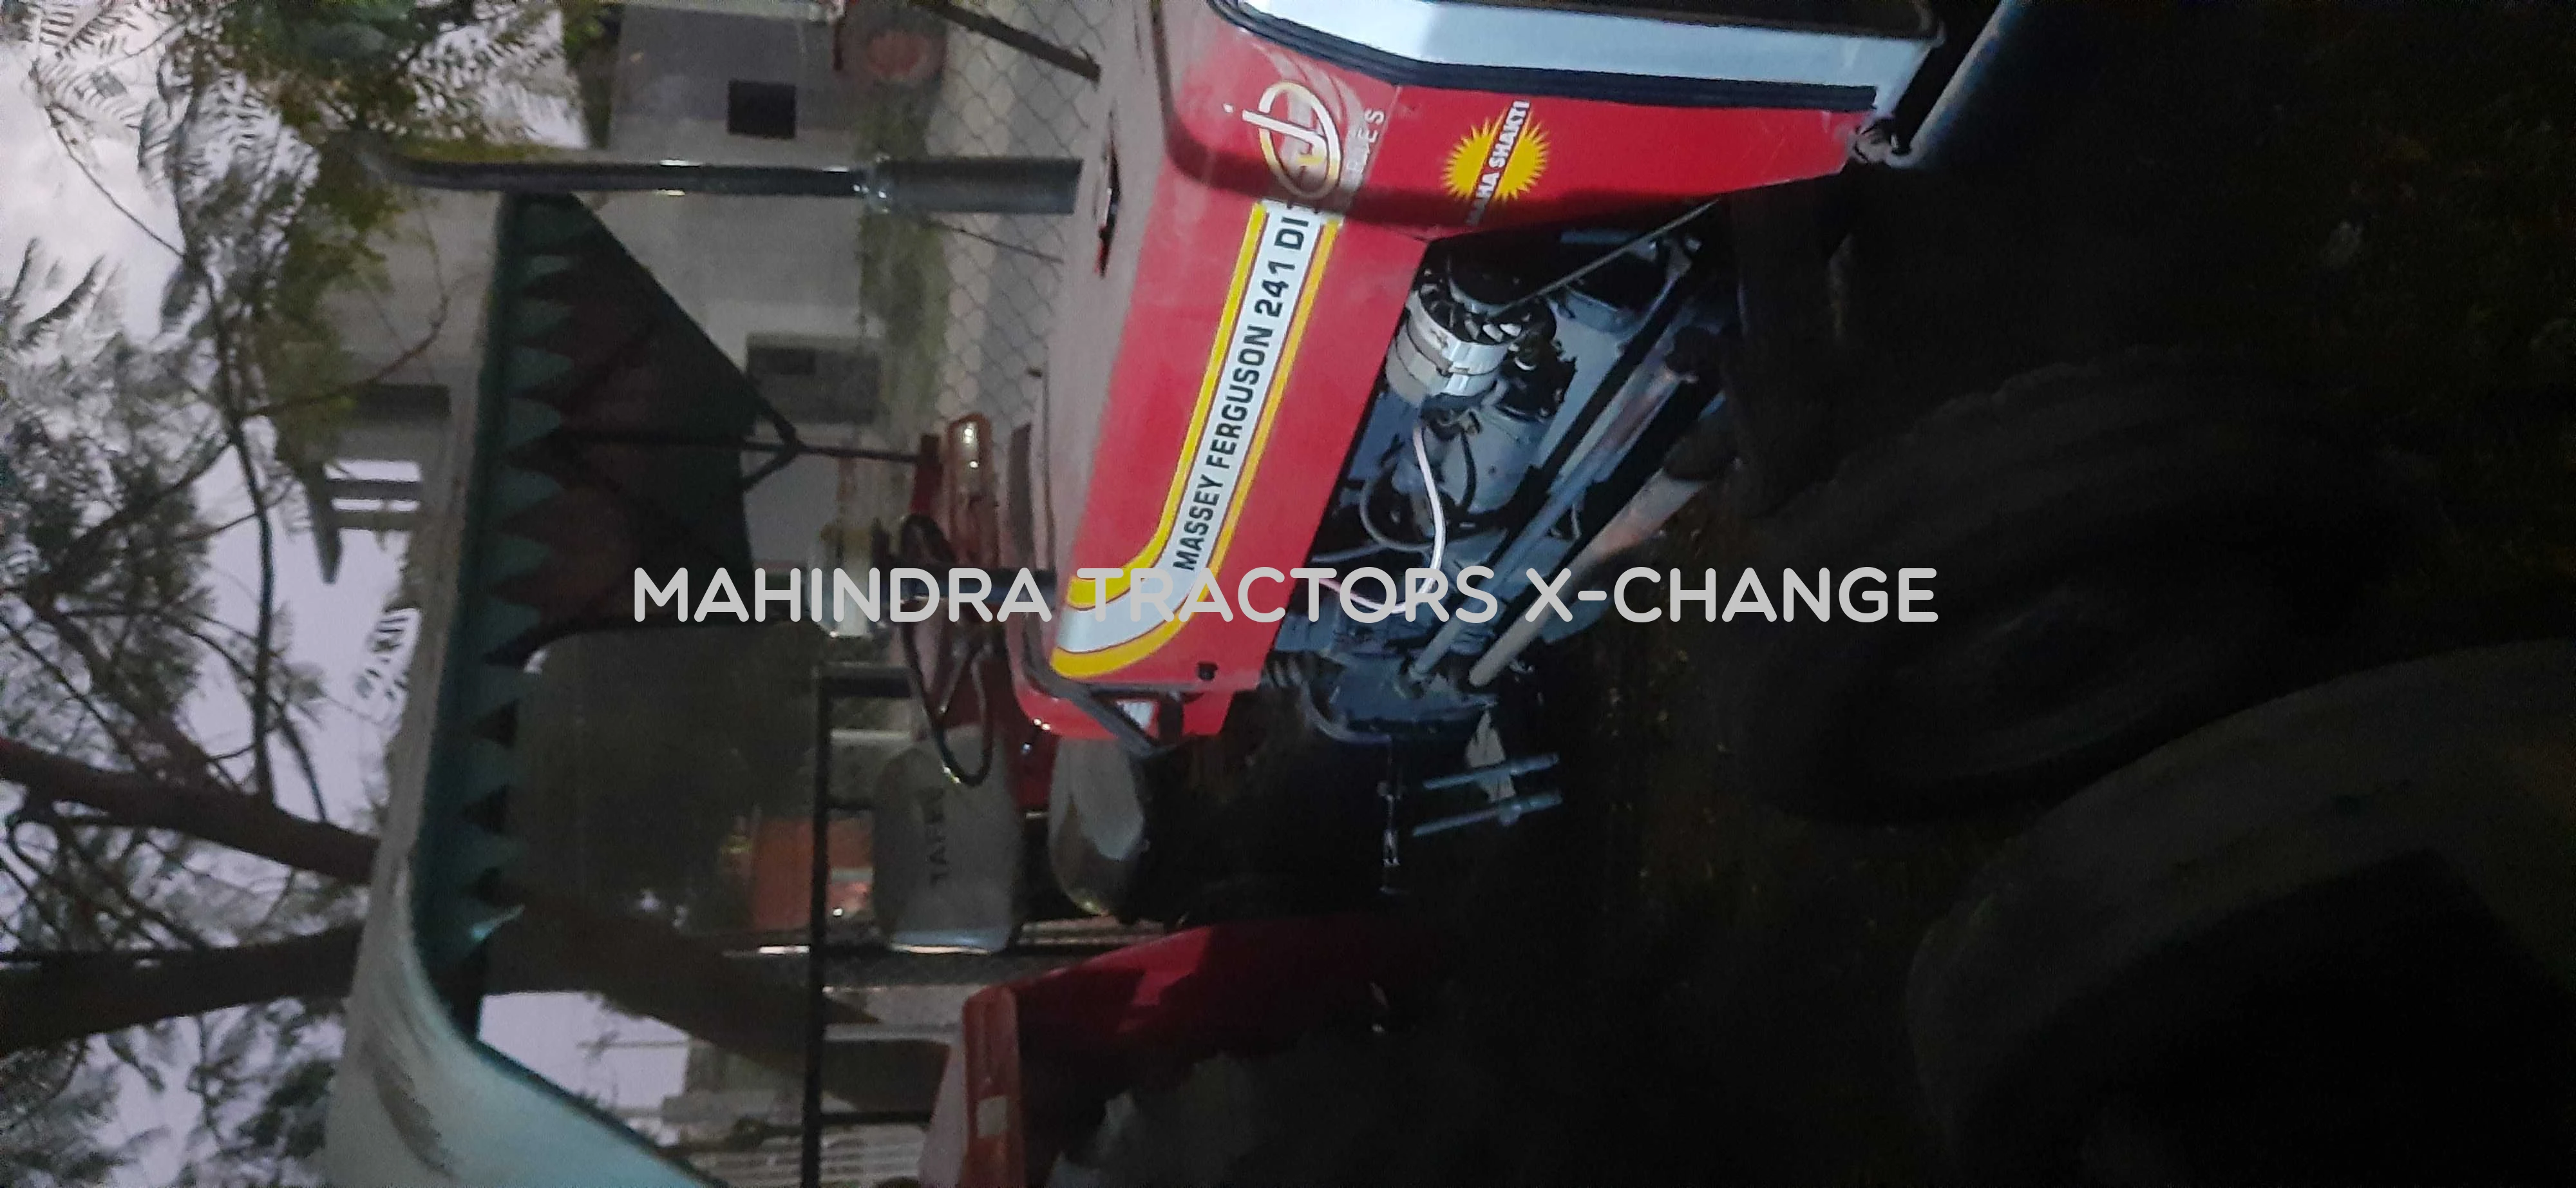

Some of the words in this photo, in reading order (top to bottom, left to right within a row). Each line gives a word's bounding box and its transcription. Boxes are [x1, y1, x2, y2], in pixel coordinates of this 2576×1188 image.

[1488, 99, 1531, 169] SHAKTI
[1274, 216, 1309, 251] DI
[1254, 260, 1296, 318] 241
[1205, 325, 1273, 469] FERGUSON
[1172, 474, 1224, 571] MASSEY
